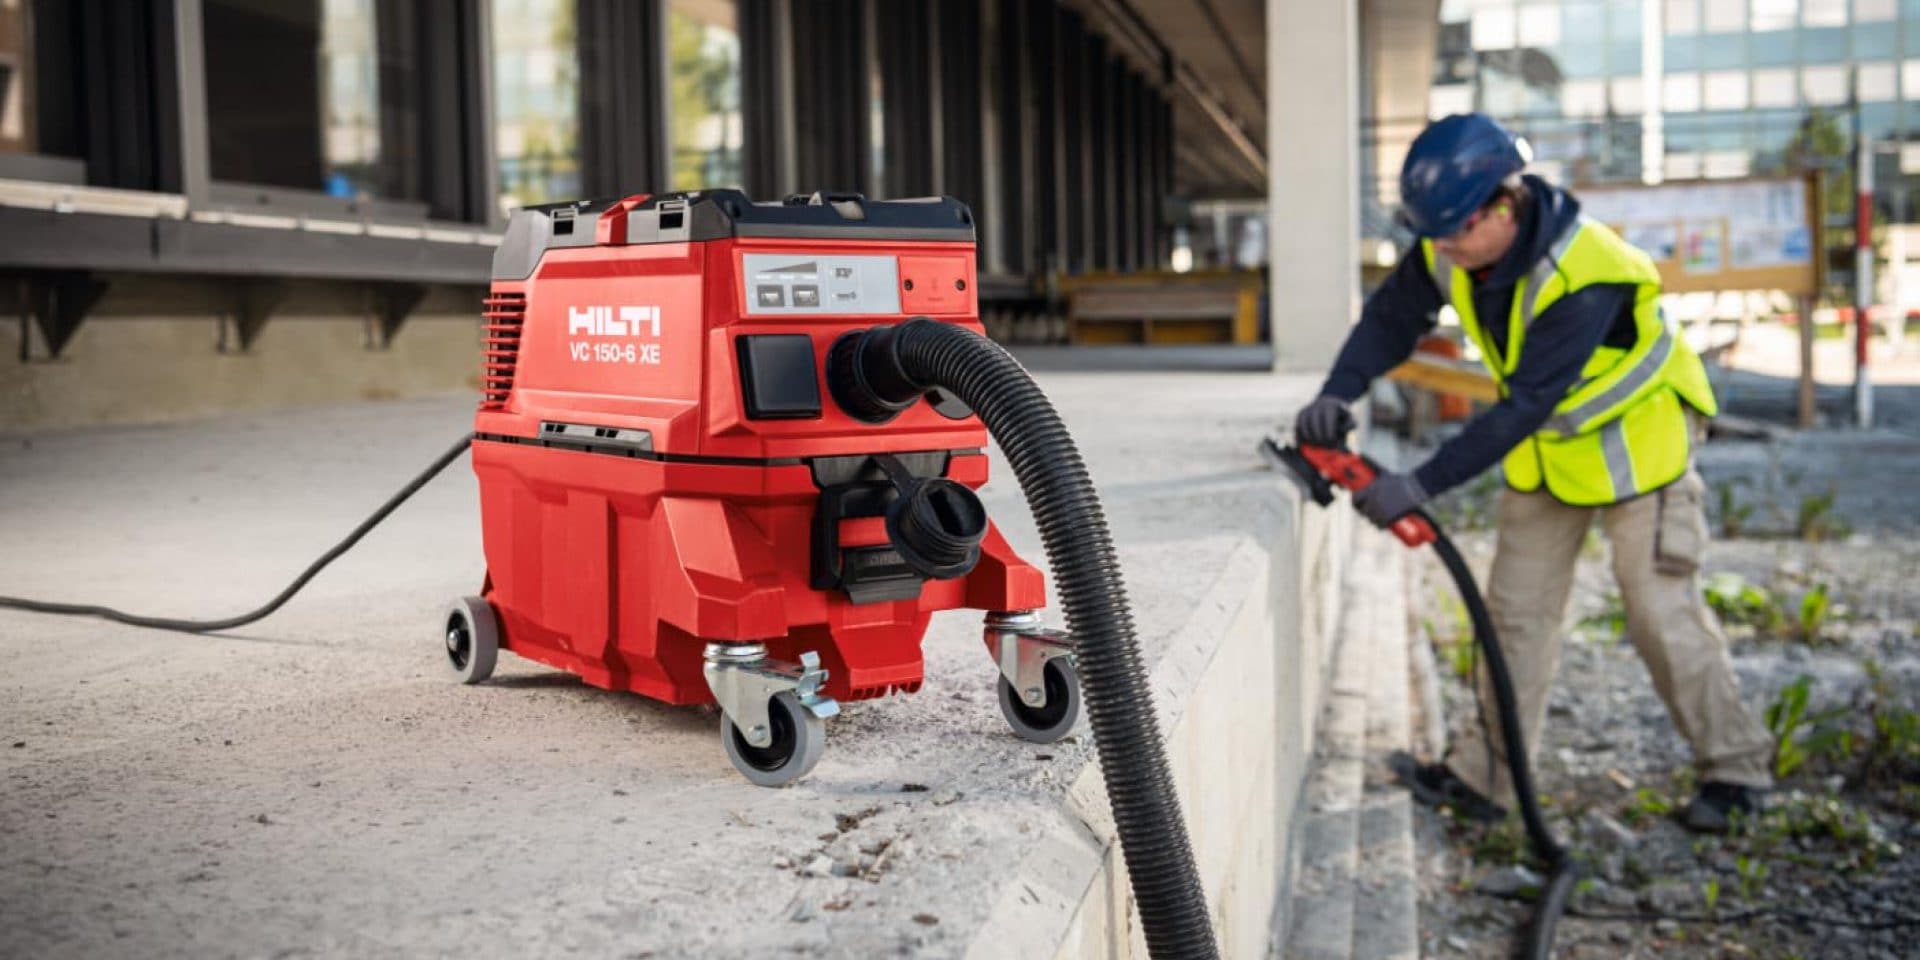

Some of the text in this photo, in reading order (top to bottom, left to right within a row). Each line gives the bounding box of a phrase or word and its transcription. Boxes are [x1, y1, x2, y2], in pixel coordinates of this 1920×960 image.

[568, 305, 661, 336] HILTI
[569, 342, 661, 365] VC 150-6 XE
